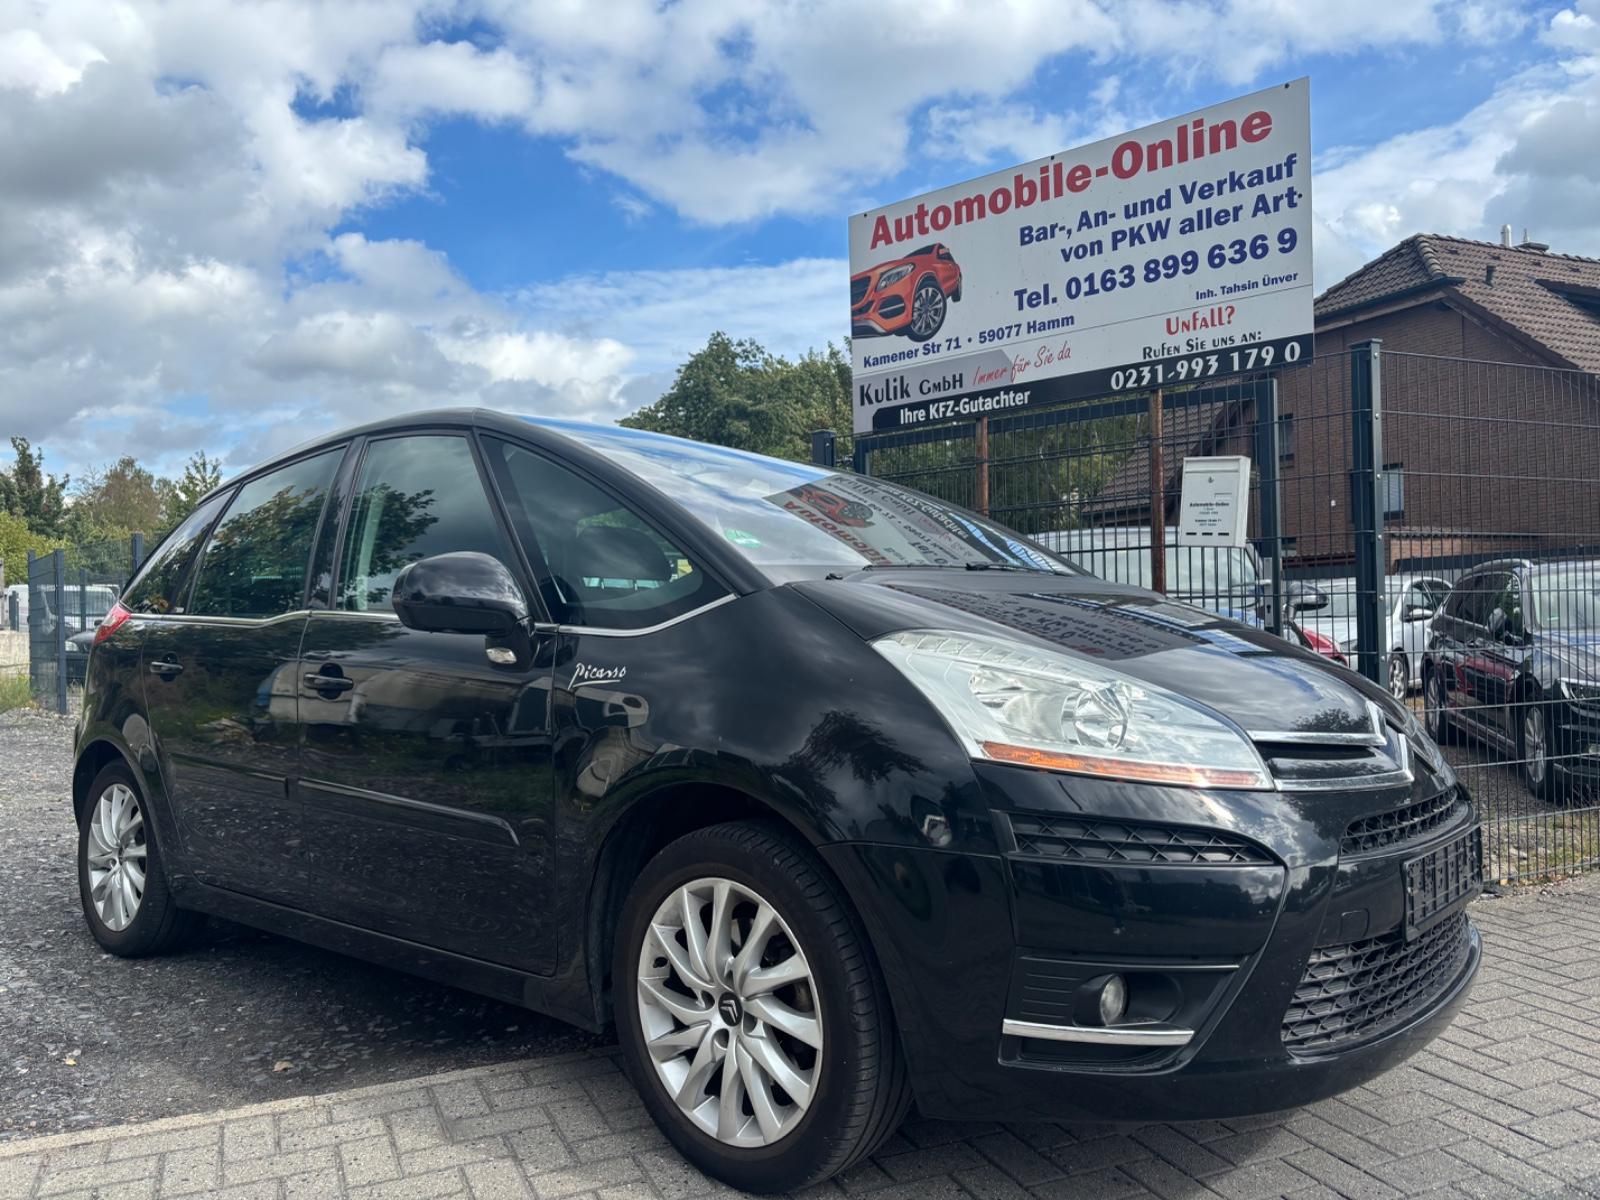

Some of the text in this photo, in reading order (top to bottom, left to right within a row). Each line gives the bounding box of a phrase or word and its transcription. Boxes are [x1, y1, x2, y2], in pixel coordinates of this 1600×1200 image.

[870, 110, 1273, 250] Automobile-Online
[1020, 153, 1297, 247] Bar-, An- und Verkauf
[1060, 239, 1103, 262] von
[1111, 217, 1172, 251] PKW
[1179, 204, 1244, 235] aller
[1014, 227, 1298, 311] Tel. 0163 899 636 9
[1196, 272, 1299, 301] Inh. Tahsin Ünver
[863, 314, 1075, 368] Kamener Str 71 59077 Hamm
[971, 340, 1072, 386] Immer für Sie da
[1110, 341, 1301, 390] 0231-993 179 0
[859, 375, 911, 407] Kulik
[900, 388, 1031, 425] Ihre KFZ-Gutachter
[567, 662, 627, 690] Picasso
